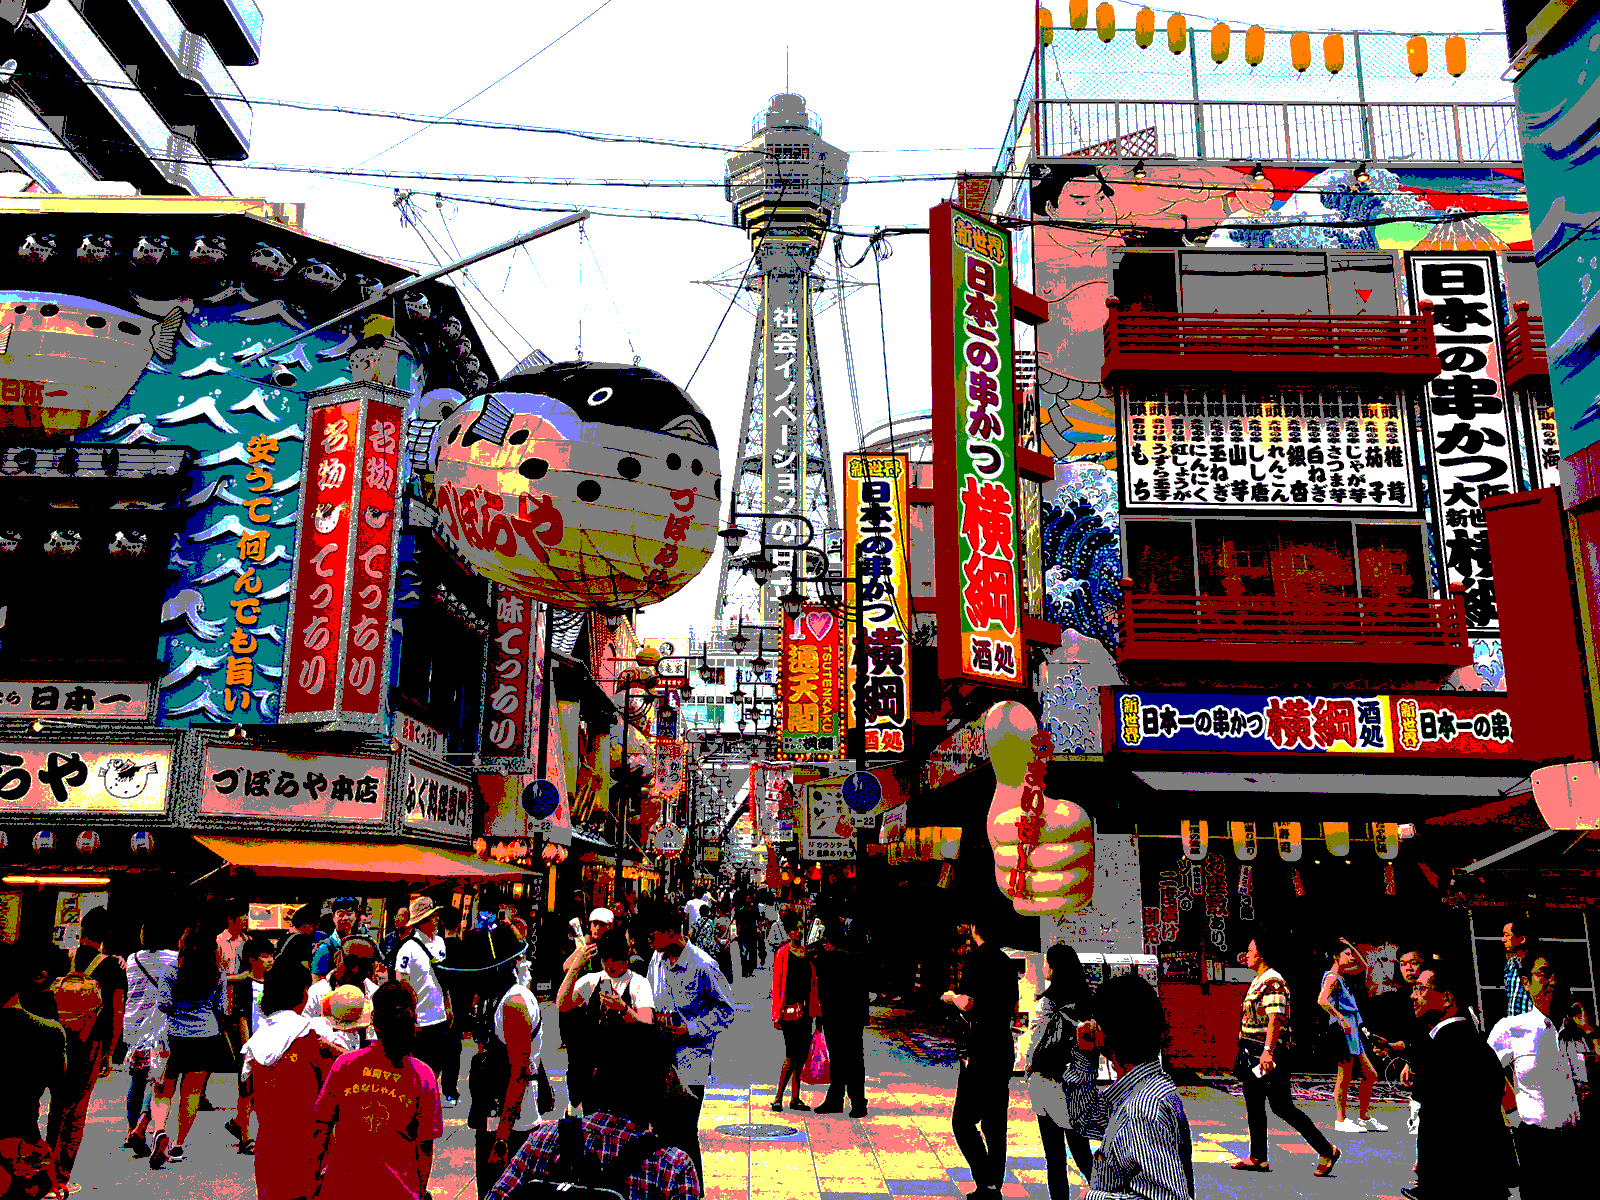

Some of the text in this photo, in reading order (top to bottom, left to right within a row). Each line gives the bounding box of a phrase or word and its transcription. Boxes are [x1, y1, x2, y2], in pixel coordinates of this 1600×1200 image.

[1421, 263, 1509, 482] 日本一の串かつ
[955, 215, 1015, 676] 新世界 日本一の串かつ 横綱 酒処
[1131, 443, 1151, 501] もち
[1170, 443, 1192, 501] 紅しょうが
[1190, 444, 1210, 502] にんにく
[1209, 444, 1231, 502] 玉ねぎ
[1229, 443, 1250, 502] 山芋
[1249, 444, 1270, 502] しし唐
[1267, 445, 1289, 502] れんこん
[1306, 445, 1328, 503] 白ねぎ
[1326, 445, 1348, 503] さつま芋
[1345, 445, 1368, 503] じゃが芋
[223, 433, 280, 713] 安うて何んでも旨い
[31, 685, 132, 712] 日本一
[821, 644, 833, 733] TSUTENKAKU
[1122, 695, 1385, 748] 新世界 日本一の串かつ 横綱 酒処
[1400, 701, 1419, 750] 新世界
[211, 766, 381, 804] づぼらや本店
